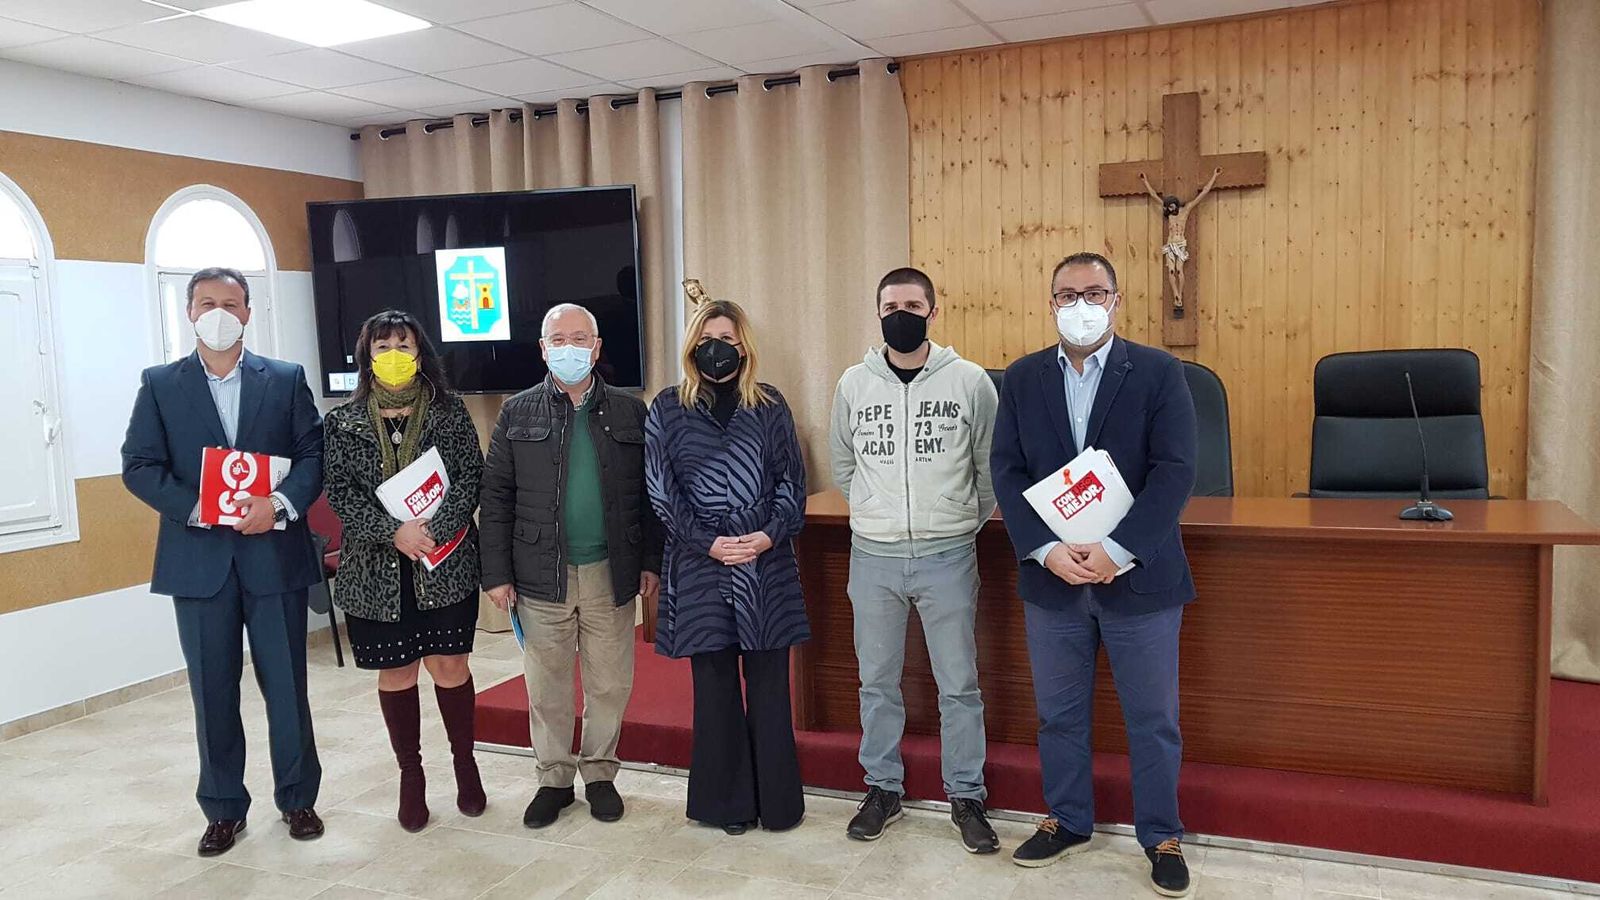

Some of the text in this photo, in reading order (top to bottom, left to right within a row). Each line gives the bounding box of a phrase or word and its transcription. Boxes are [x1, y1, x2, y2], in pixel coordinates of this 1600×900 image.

[857, 400, 960, 425] PEPE JEANS
[877, 423, 894, 439] 19
[914, 420, 932, 437] 73
[861, 437, 945, 456] ACAD EMY.
[407, 488, 425, 506] CON
[1055, 490, 1076, 508] CON
[1061, 483, 1104, 517] MEJOR.
